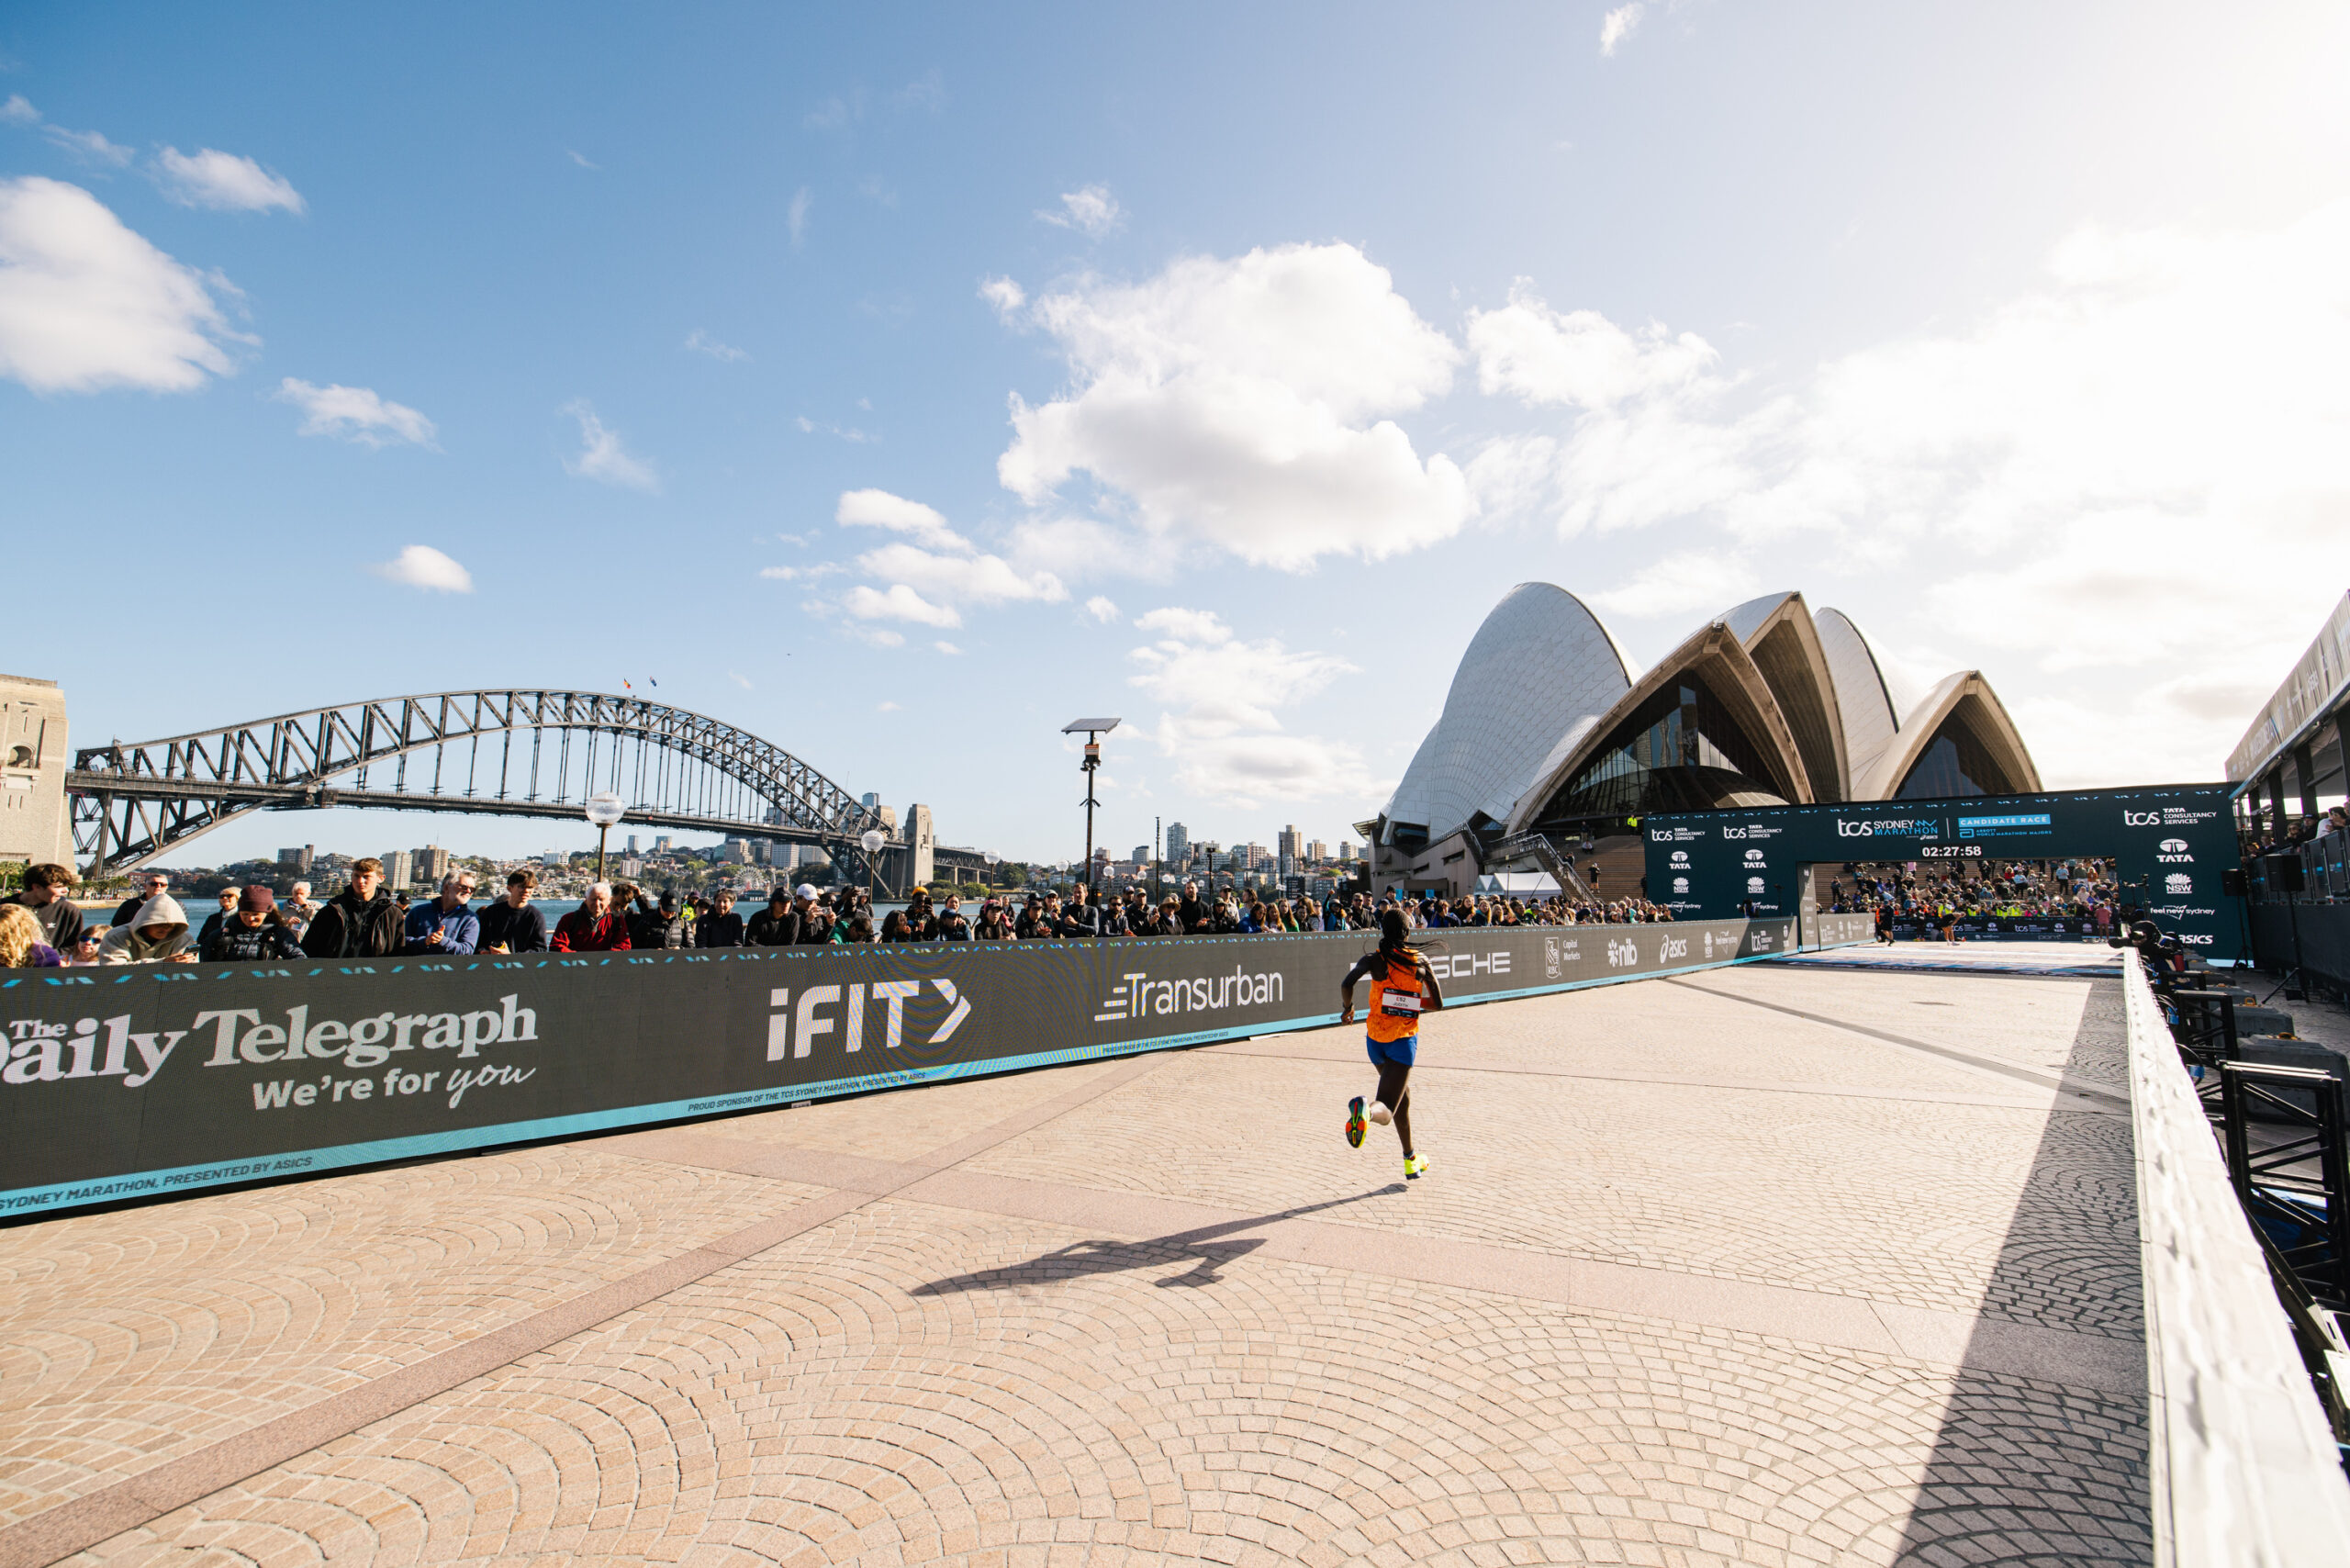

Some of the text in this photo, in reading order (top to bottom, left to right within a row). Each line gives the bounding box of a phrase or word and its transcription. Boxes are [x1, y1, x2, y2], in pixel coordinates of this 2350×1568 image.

[1874, 820, 1914, 829] SYDNEY
[2124, 810, 2160, 825] tcs
[1724, 825, 1746, 838] tcs
[1838, 819, 1873, 836] tcs
[1874, 826, 1938, 835] MARATHON
[1651, 828, 1673, 842] tcs
[1922, 846, 1982, 857] 02:27:58
[2186, 907, 2215, 915] sydney
[1563, 939, 1577, 951] Capital
[1563, 952, 1581, 960] Markets
[1618, 938, 1637, 967] nib
[1548, 966, 1559, 975] RBC
[1124, 964, 1283, 1018] Transurban
[9, 1019, 68, 1039] The
[193, 993, 539, 1069] Telegraph
[252, 1064, 537, 1110] We're for you
[688, 1101, 716, 1112] PROUD
[716, 1096, 753, 1108] SPONSOR
[753, 1094, 764, 1103] OF
[765, 1092, 779, 1101] THE
[780, 1090, 794, 1099] TCS
[795, 1086, 822, 1097] SYDNEY
[0, 1192, 64, 1209] SYDNEY
[163, 1165, 250, 1186] PRESENTED
[252, 1162, 271, 1173] BY
[274, 1157, 313, 1170] ASICS
